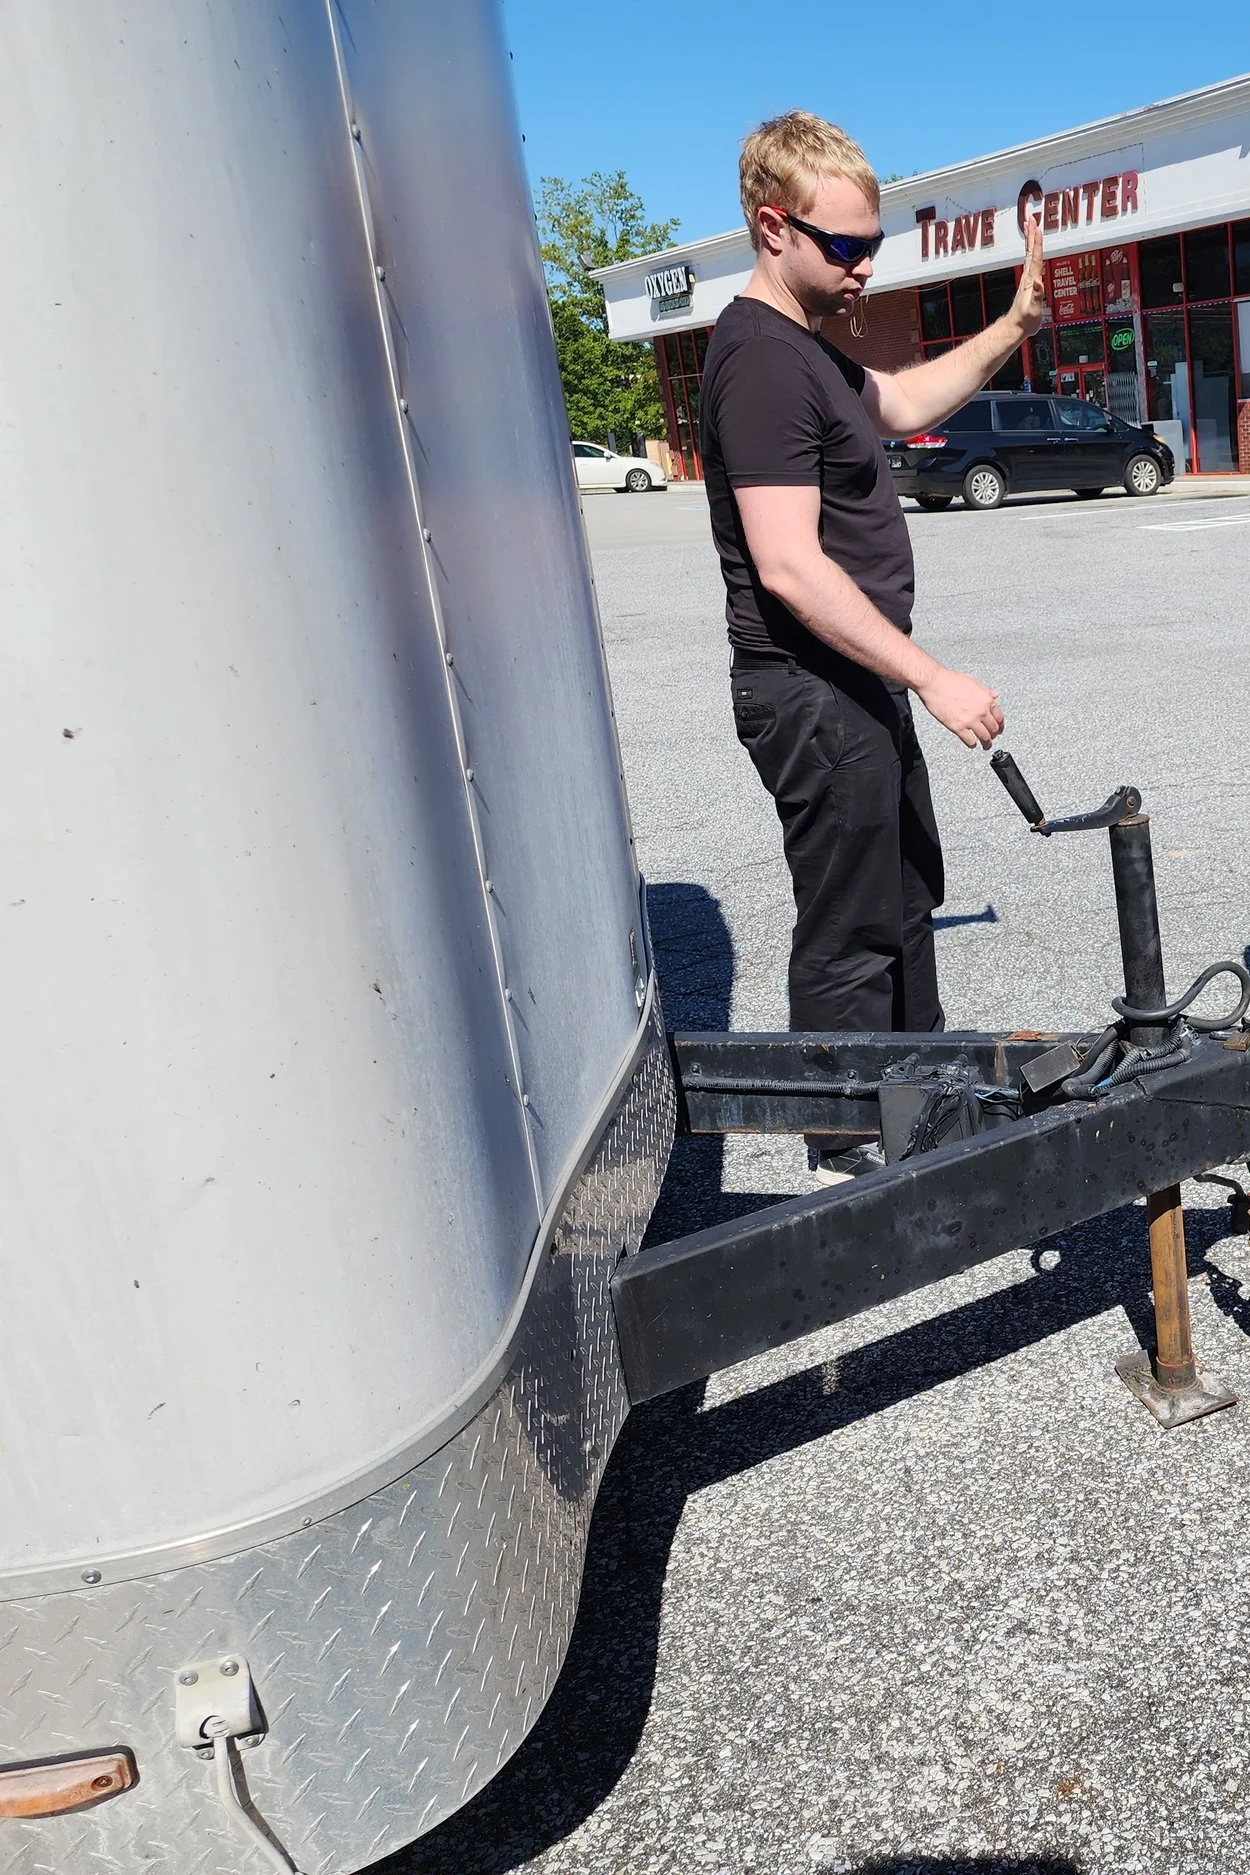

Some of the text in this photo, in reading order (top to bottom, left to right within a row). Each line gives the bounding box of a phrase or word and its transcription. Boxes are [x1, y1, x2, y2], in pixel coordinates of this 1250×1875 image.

[915, 170, 1139, 262] TRAVE CENTER
[1054, 266, 1074, 278] SHELL
[644, 266, 688, 299] OXYGEN
[1053, 276, 1077, 288] TRAVEL
[1053, 286, 1078, 299] CENTER
[1113, 331, 1133, 347] OPEN
